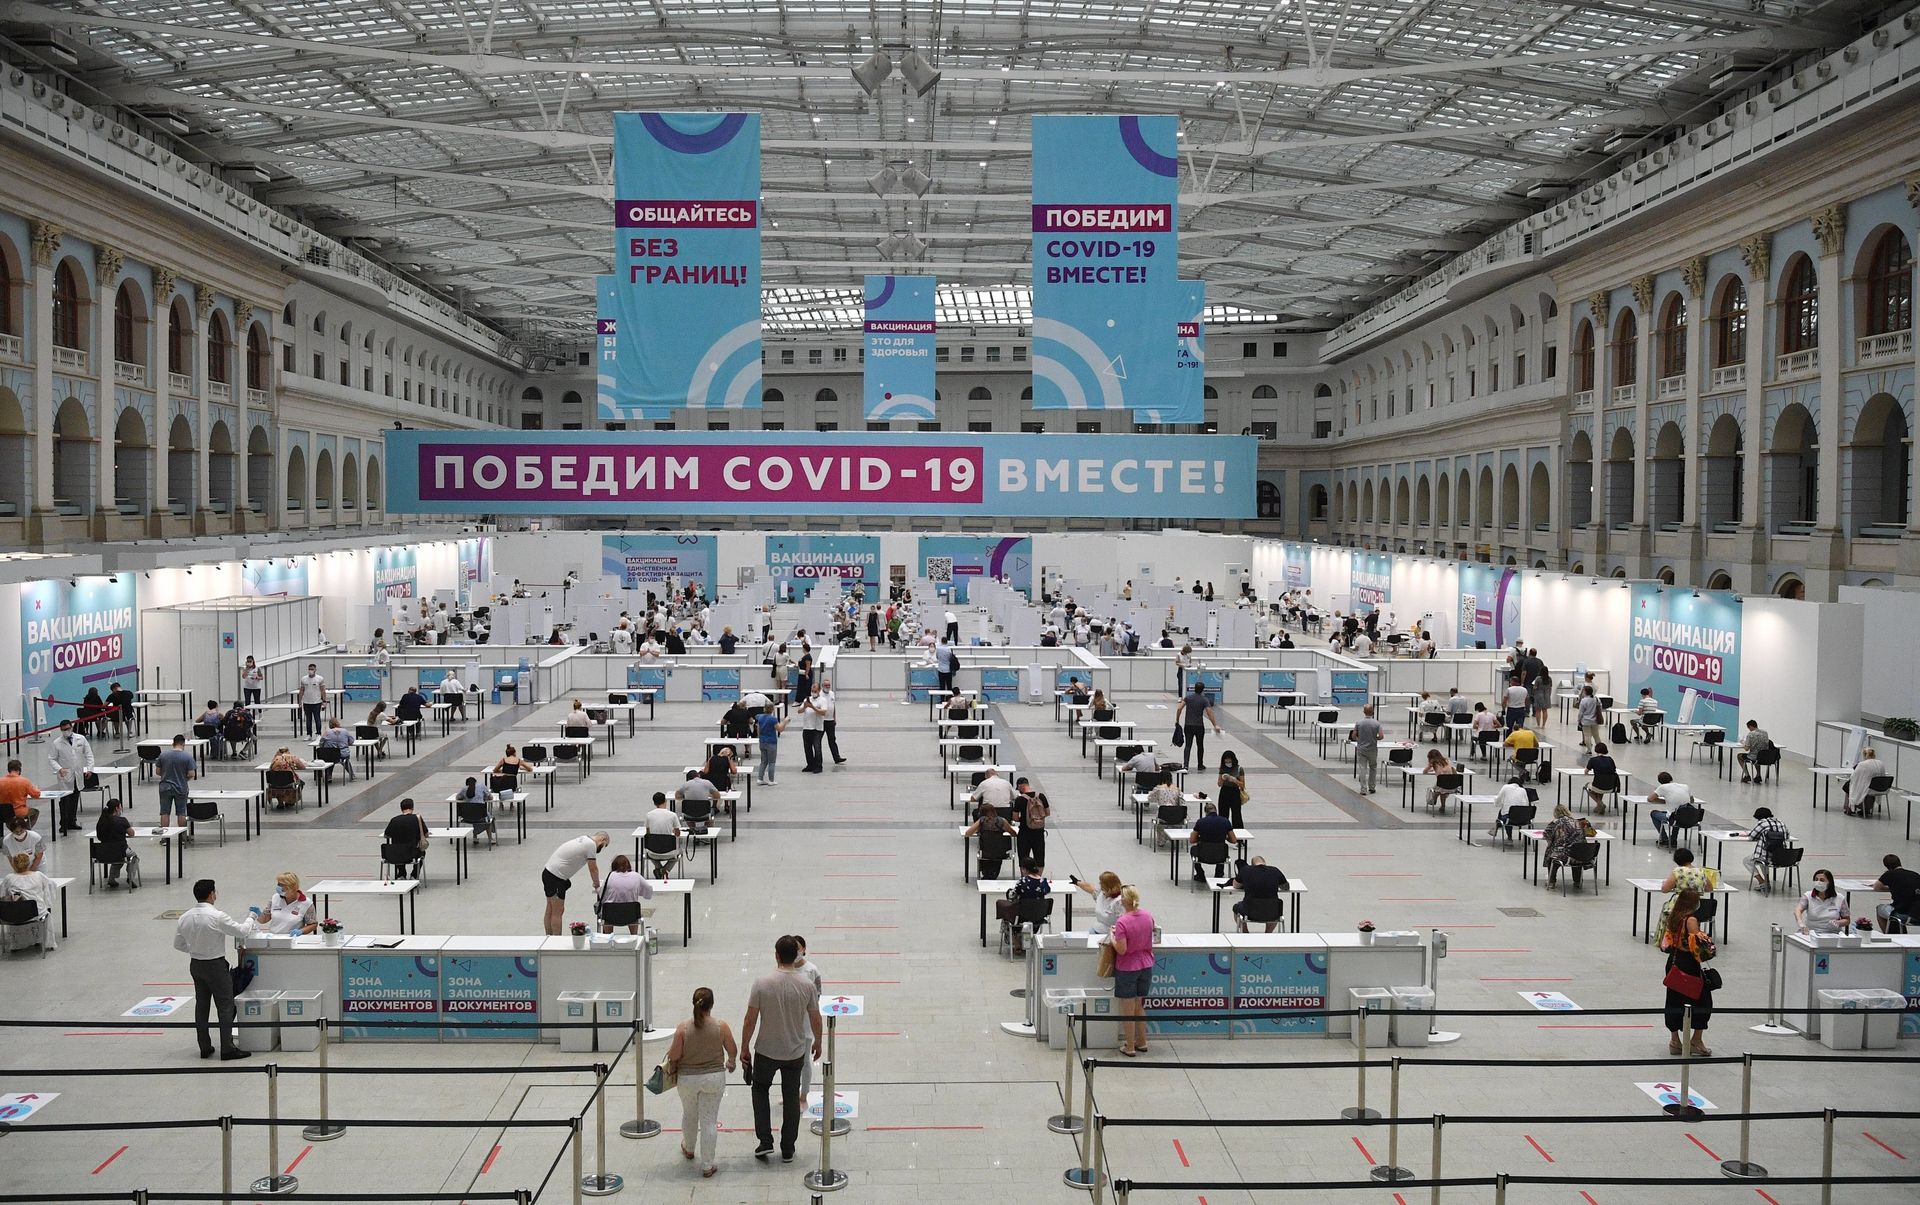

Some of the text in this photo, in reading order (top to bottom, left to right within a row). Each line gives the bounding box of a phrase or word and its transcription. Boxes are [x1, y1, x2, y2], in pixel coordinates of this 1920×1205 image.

[630, 204, 752, 224] ОБЩАЙТЕСЬ
[1047, 209, 1164, 229] ПОБЕДИМ
[631, 238, 679, 257] БЕЗ
[1047, 240, 1156, 258] COVID-19
[631, 265, 747, 288] ГРАНИЦ!
[1047, 266, 1147, 284] ВМЕСТЕ!
[870, 323, 932, 332] ВАКЦИНАЦИЯ
[871, 337, 915, 347] ЭТО ДЛЯ
[871, 348, 929, 358] ЗДОРОВЬЯ!
[435, 455, 1226, 496] ПОБЕДИМ COVID-19 ВМЕСТЕ!
[770, 552, 875, 565] ВАКЦИНАЦИЯ
[376, 565, 416, 584] ВАКЦИНАЦИЯ
[770, 566, 863, 577] ОТ COVID-19
[27, 606, 132, 645] ВАКЦИНАЦИЯ
[1634, 616, 1736, 655] ВАКЦИНАЦИЯ
[28, 635, 121, 675] ОТ COVID-19
[1633, 643, 1721, 682] ОТ COVID-19
[1045, 958, 1055, 971] 3
[1817, 958, 1828, 970] 4
[348, 977, 382, 986] ЗОНА
[448, 977, 482, 986] ЗОНА
[1151, 974, 1177, 984] ОНА
[1240, 974, 1273, 983] ЗОНА
[348, 989, 431, 998] ЗАПОЛНЕНИЯ
[448, 989, 531, 998] ЗАПОЛНЕНИЯ
[1148, 986, 1224, 996] АПОЛНЕНИЯ
[1240, 986, 1319, 995] ЗАПОЛНЕНИЯ
[348, 1001, 433, 1011] ДОКУМЕНТОВ
[448, 1001, 533, 1011] ДОКУМЕНТОВ
[1144, 998, 1225, 1009] ДОКУМЕНТОВ
[1239, 997, 1321, 1008] ДОКУМЕНТОВ
